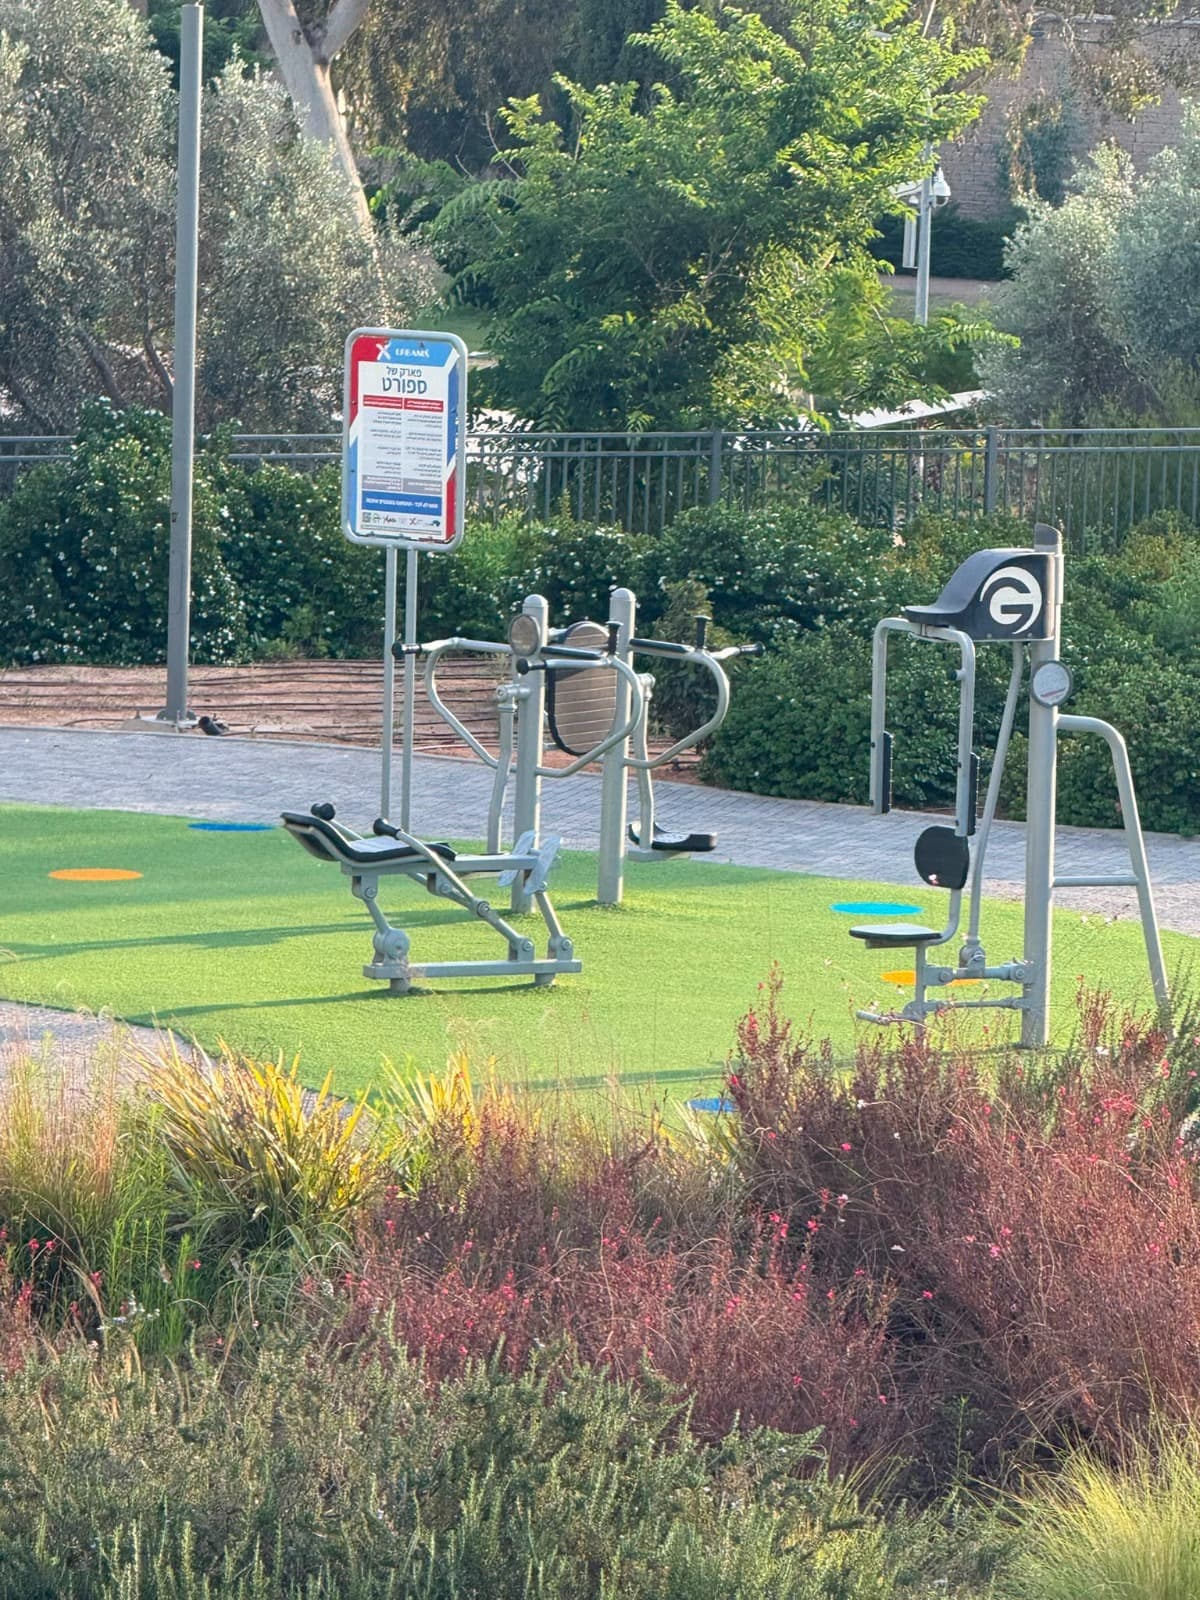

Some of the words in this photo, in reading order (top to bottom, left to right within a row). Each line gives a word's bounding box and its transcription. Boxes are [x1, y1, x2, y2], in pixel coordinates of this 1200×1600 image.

[386, 365, 398, 376] של
[399, 367, 422, 378] פארק
[382, 376, 428, 395] ספורט
